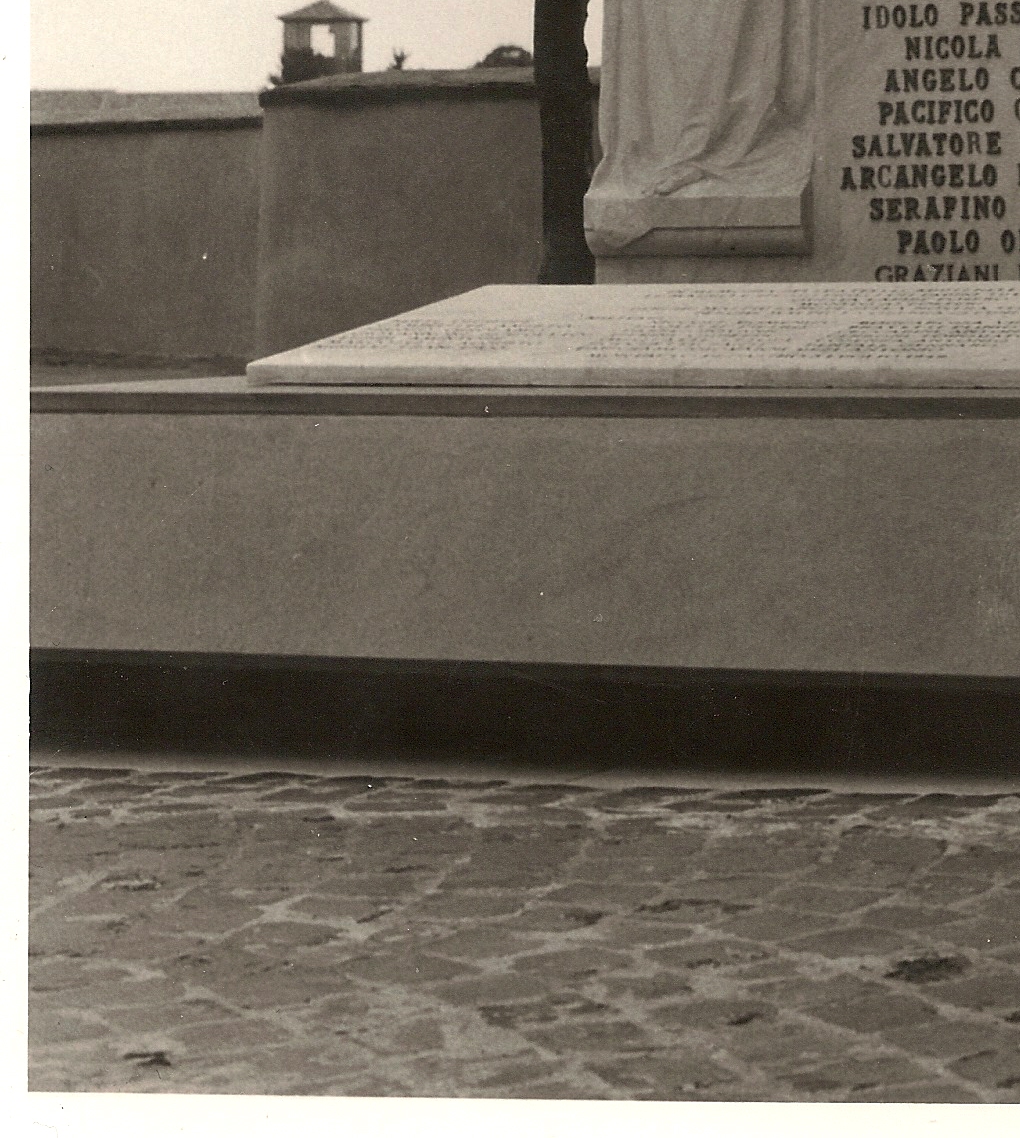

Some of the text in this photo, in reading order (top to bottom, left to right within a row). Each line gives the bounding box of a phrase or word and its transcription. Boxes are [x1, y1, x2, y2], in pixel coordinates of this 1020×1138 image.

[862, 4, 939, 30] IDOLO
[905, 34, 1001, 60] NICOLA
[884, 68, 989, 93] ANGELO
[878, 100, 994, 126] PACIFICO
[852, 132, 1001, 158] SALVATORE
[840, 164, 998, 190] ARCANGELO
[870, 196, 1006, 222] SERAFINO
[897, 229, 980, 254] PAOLO
[874, 264, 999, 282] GRAZIANI
